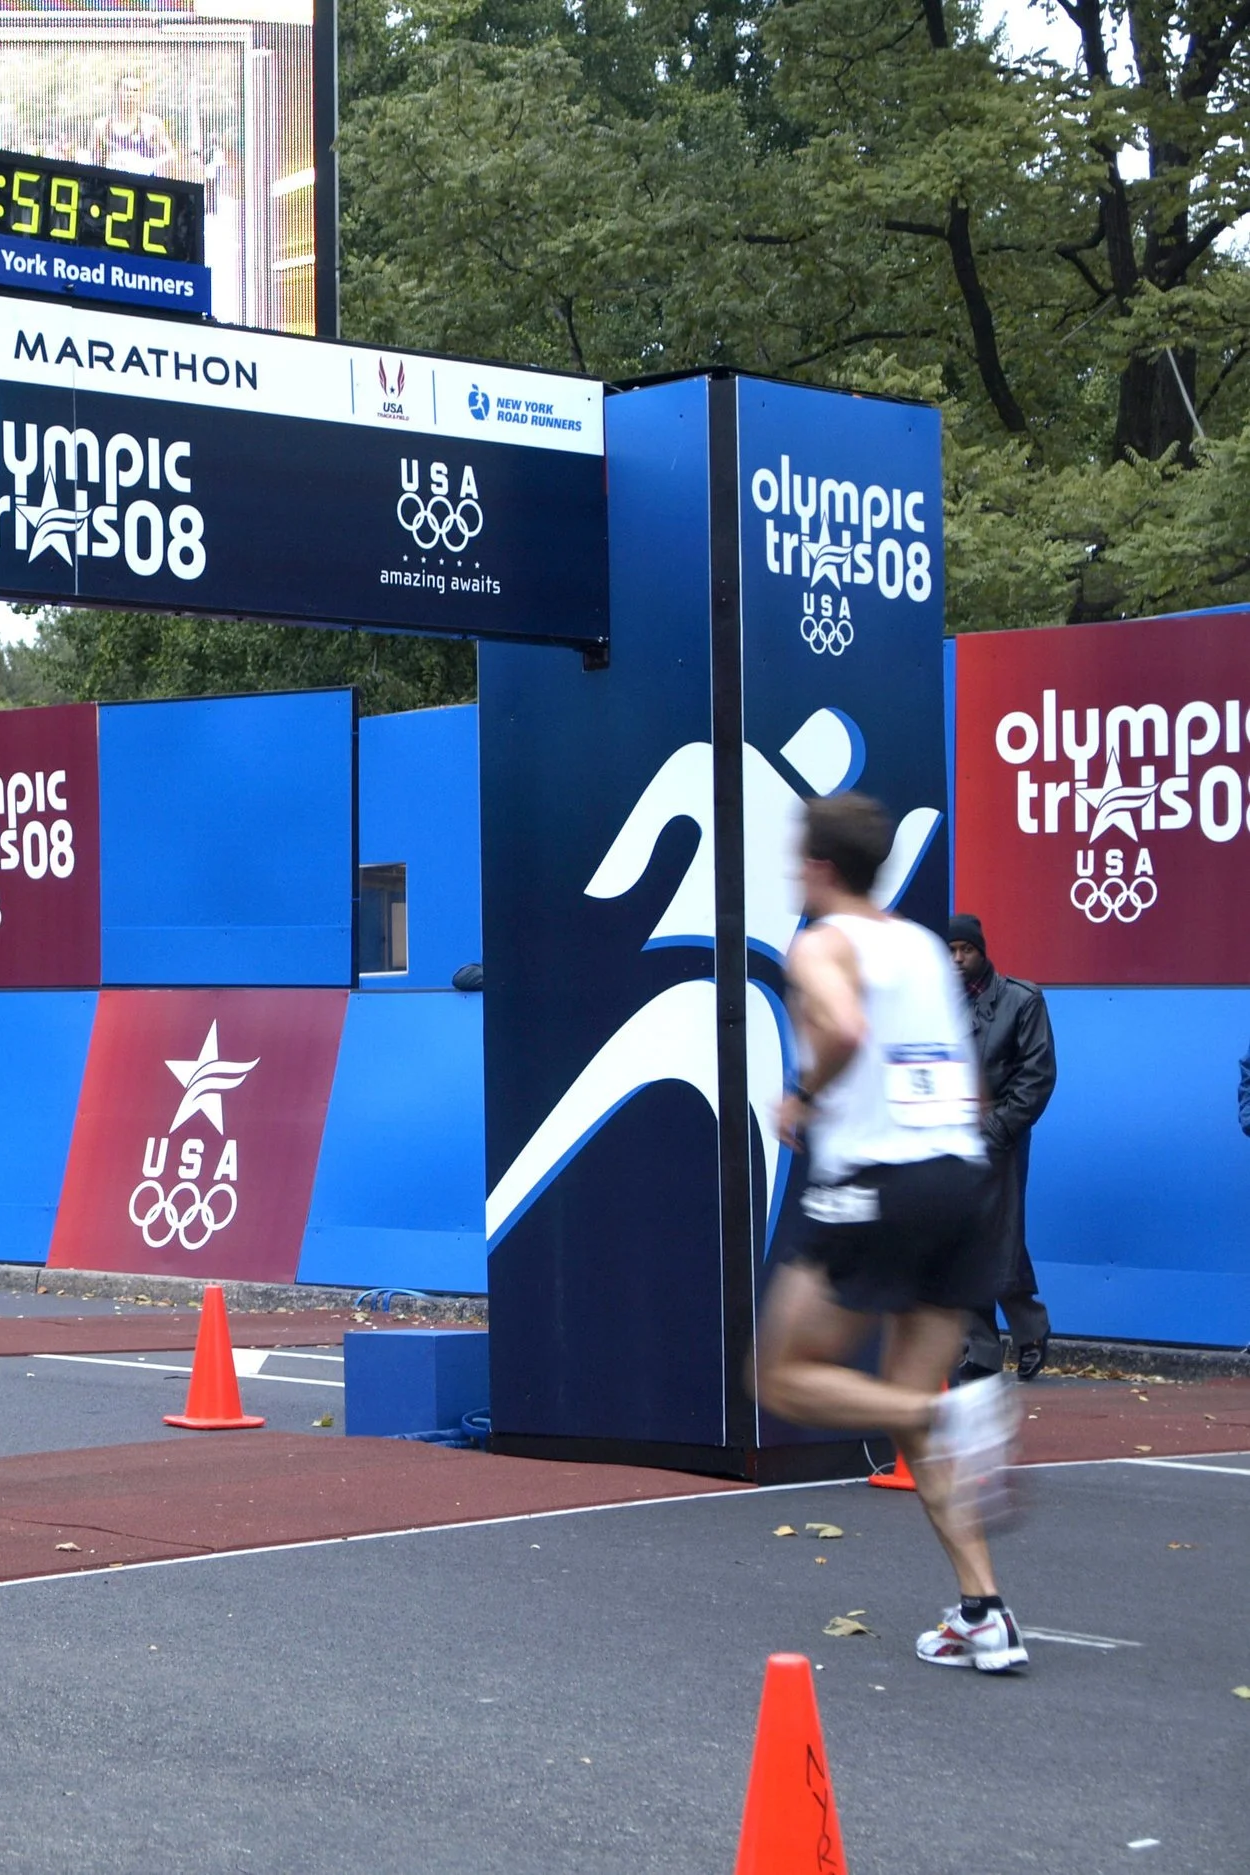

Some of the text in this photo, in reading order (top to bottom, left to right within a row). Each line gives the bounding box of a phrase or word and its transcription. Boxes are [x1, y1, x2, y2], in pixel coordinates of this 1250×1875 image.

[0, 250, 47, 277] York
[53, 258, 105, 285] Road
[110, 266, 194, 297] Runners
[14, 330, 258, 391] MARATHON
[383, 401, 403, 414] USA
[496, 398, 554, 415] NEW YORK
[497, 412, 582, 432] ROAD RUNNERS
[400, 457, 479, 499] USA
[751, 454, 925, 543] olympic
[380, 569, 501, 594] amazing awaits
[803, 591, 851, 619] USA
[995, 689, 1250, 776] olympi
[1076, 847, 1154, 877] USA
[142, 1136, 238, 1182] USA
